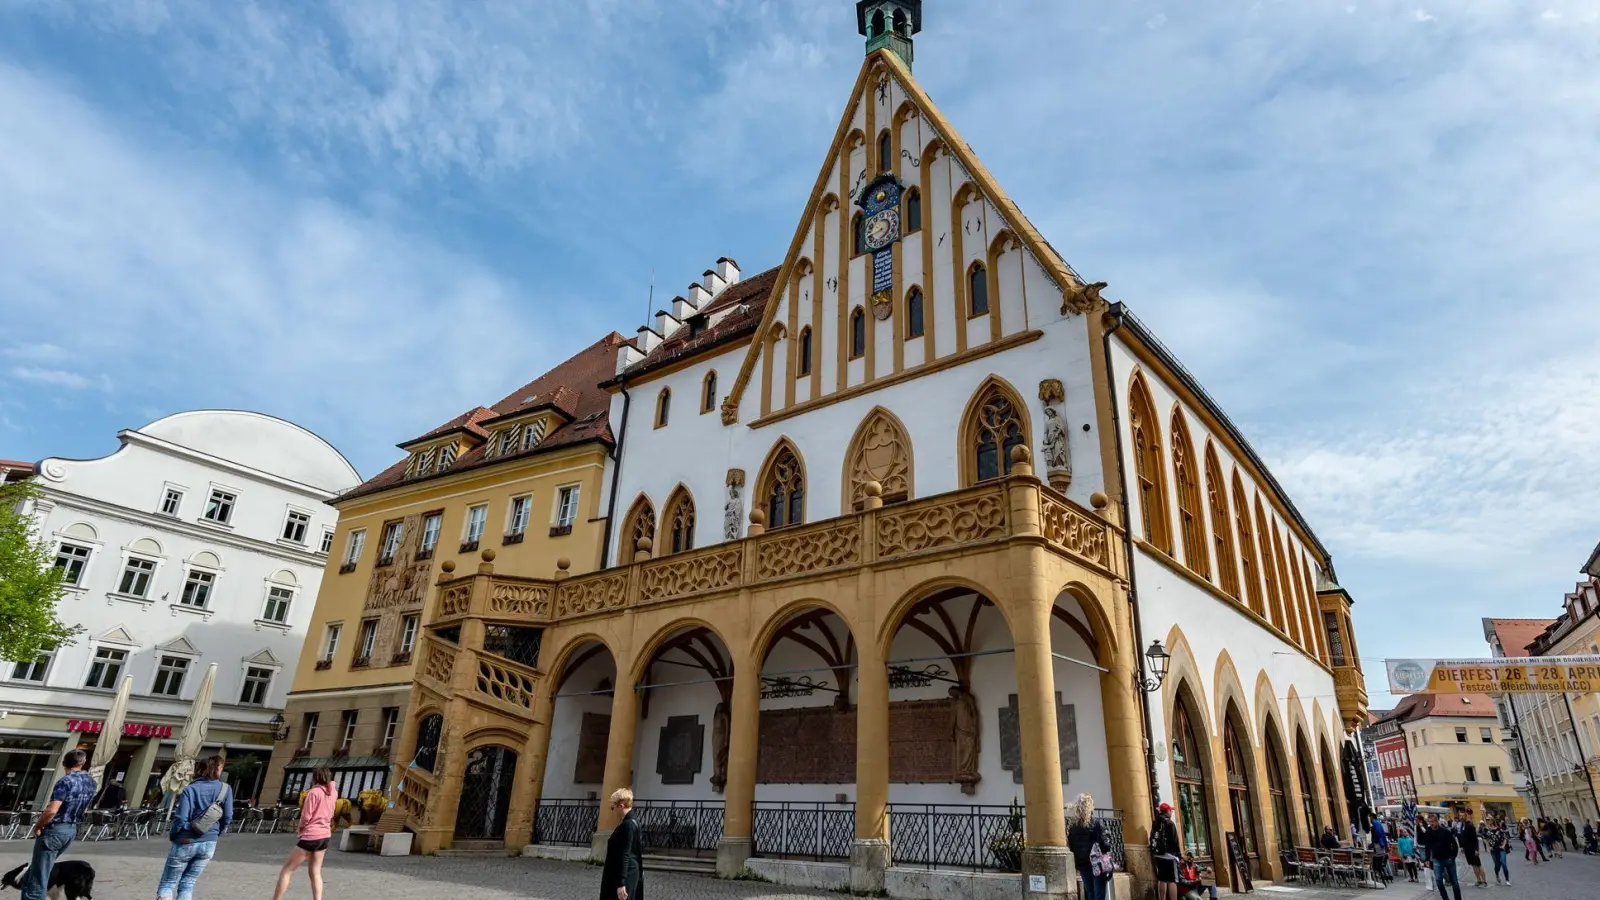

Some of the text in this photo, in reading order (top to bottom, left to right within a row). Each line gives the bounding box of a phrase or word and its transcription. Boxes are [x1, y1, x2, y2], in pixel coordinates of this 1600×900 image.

[1437, 668, 1500, 681] BIERFEST
[1505, 667, 1527, 680] 26.
[1542, 667, 1564, 680] 28.
[1459, 680, 1591, 692] Festzelt Bleichwiese (ACC)
